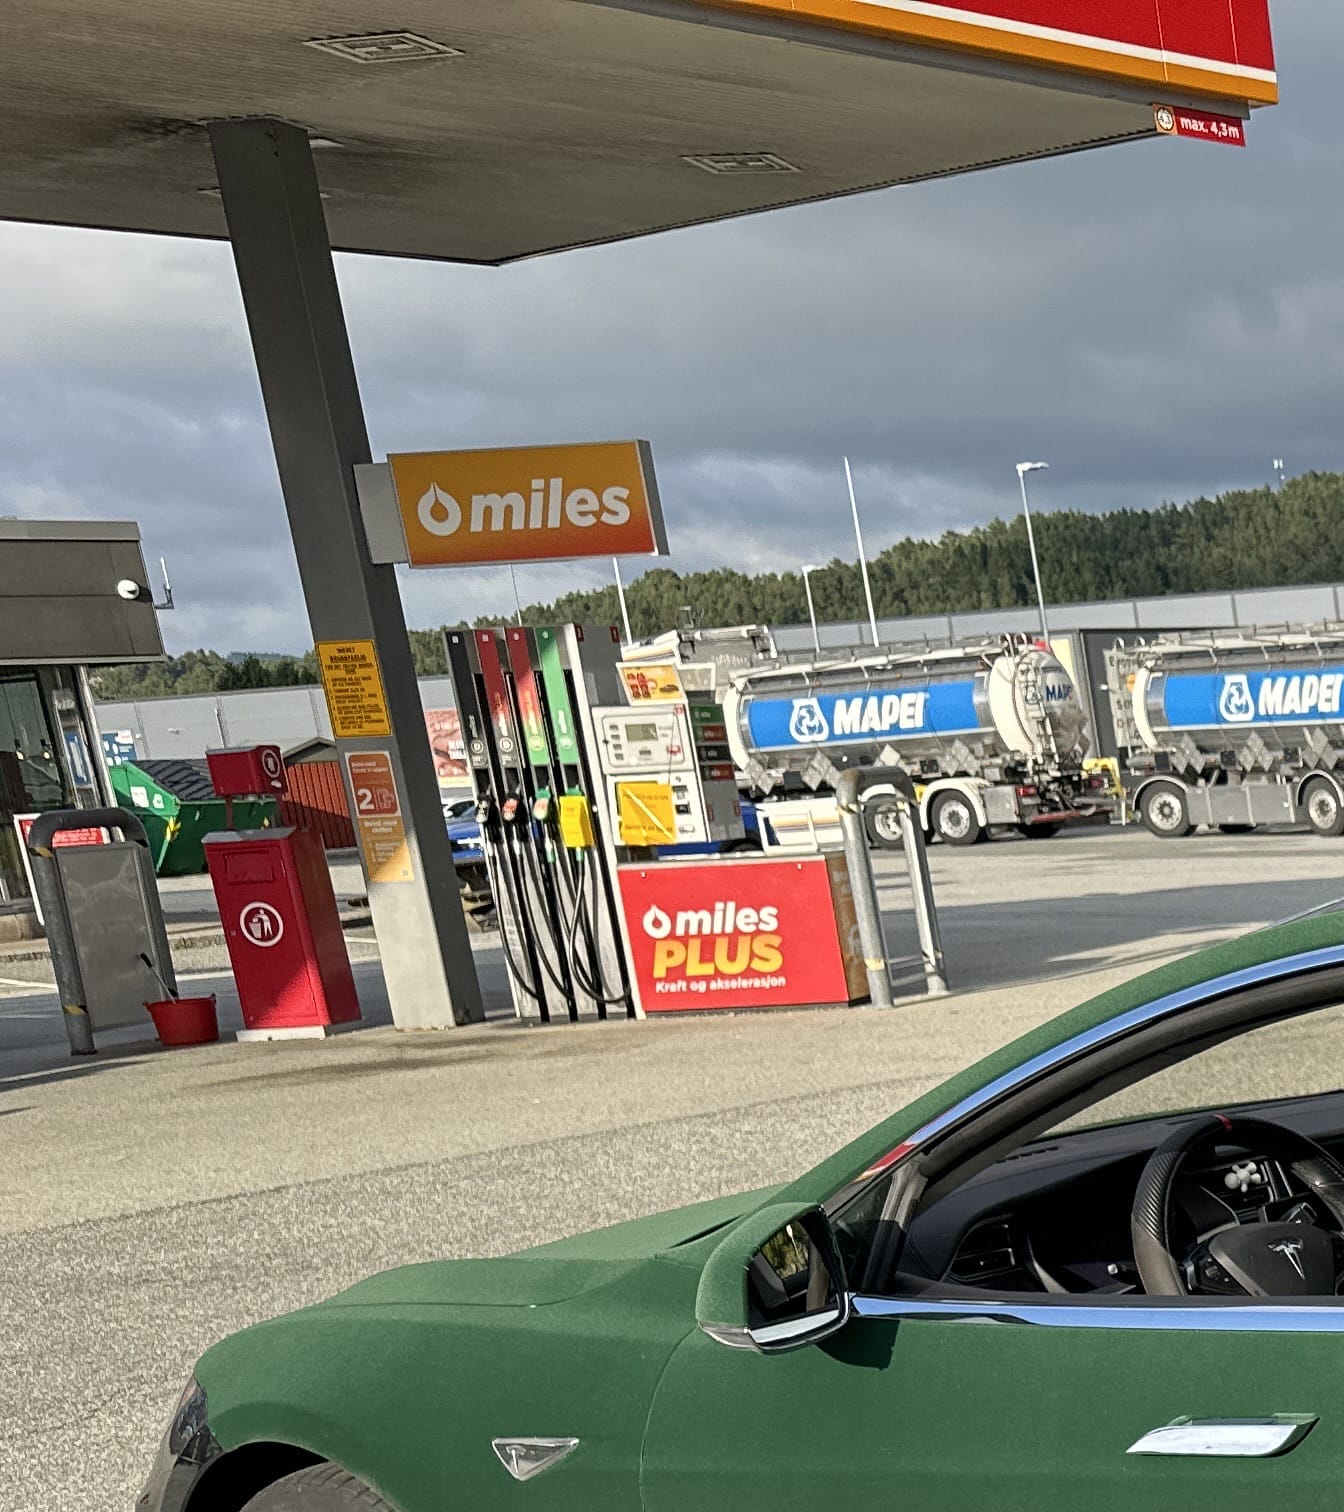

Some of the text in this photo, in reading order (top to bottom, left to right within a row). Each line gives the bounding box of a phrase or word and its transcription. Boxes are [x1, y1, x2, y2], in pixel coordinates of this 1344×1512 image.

[1180, 117, 1240, 139] max. 4,3m
[470, 477, 631, 533] miles
[833, 691, 926, 735] MAPEI
[1258, 673, 1343, 716] MAPEI
[357, 788, 375, 810] 2
[675, 901, 779, 937] miles
[653, 934, 783, 979] PLUS
[656, 975, 787, 994] Kraft og akselerasjon
